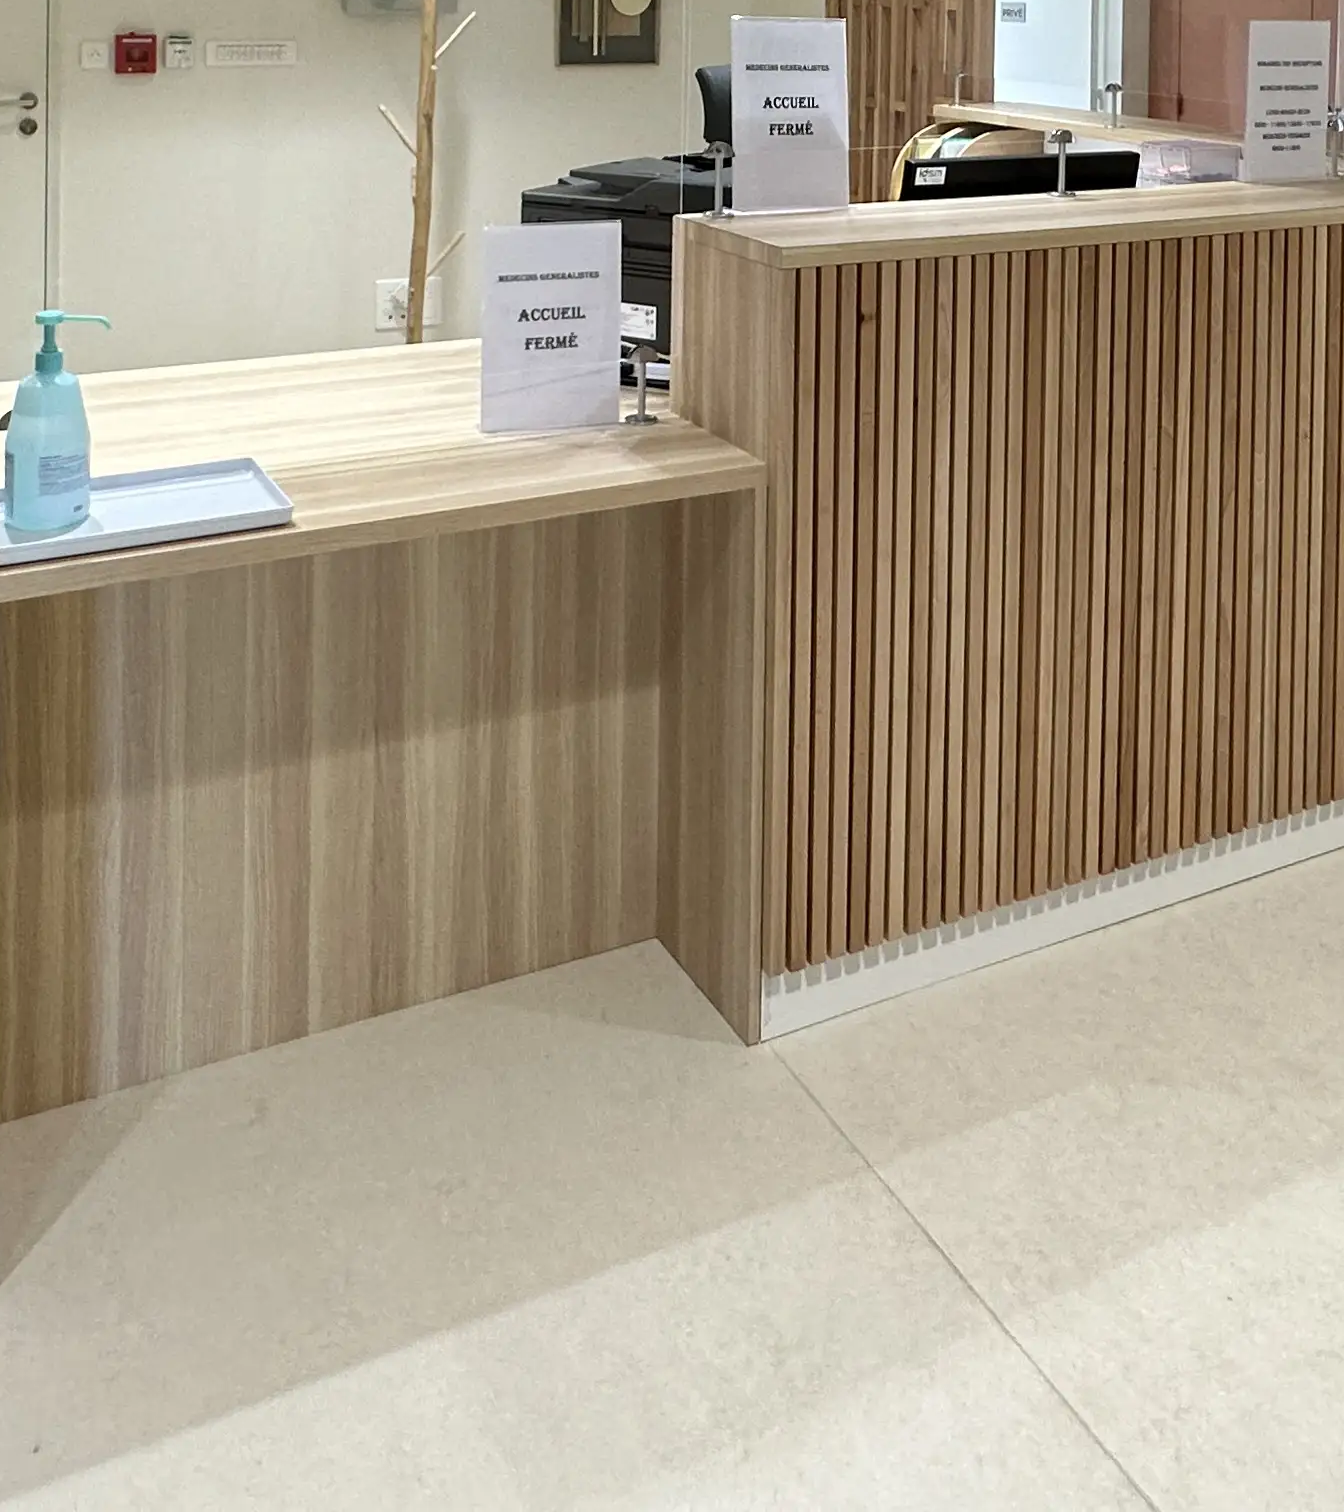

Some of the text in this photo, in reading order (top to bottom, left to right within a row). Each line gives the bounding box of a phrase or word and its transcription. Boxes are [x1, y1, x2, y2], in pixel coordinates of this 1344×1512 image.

[762, 96, 820, 109] ACCUEIL
[769, 120, 814, 136] FERMÉ
[517, 306, 586, 323] ACCUEIL
[524, 332, 579, 350] FERMÉ
